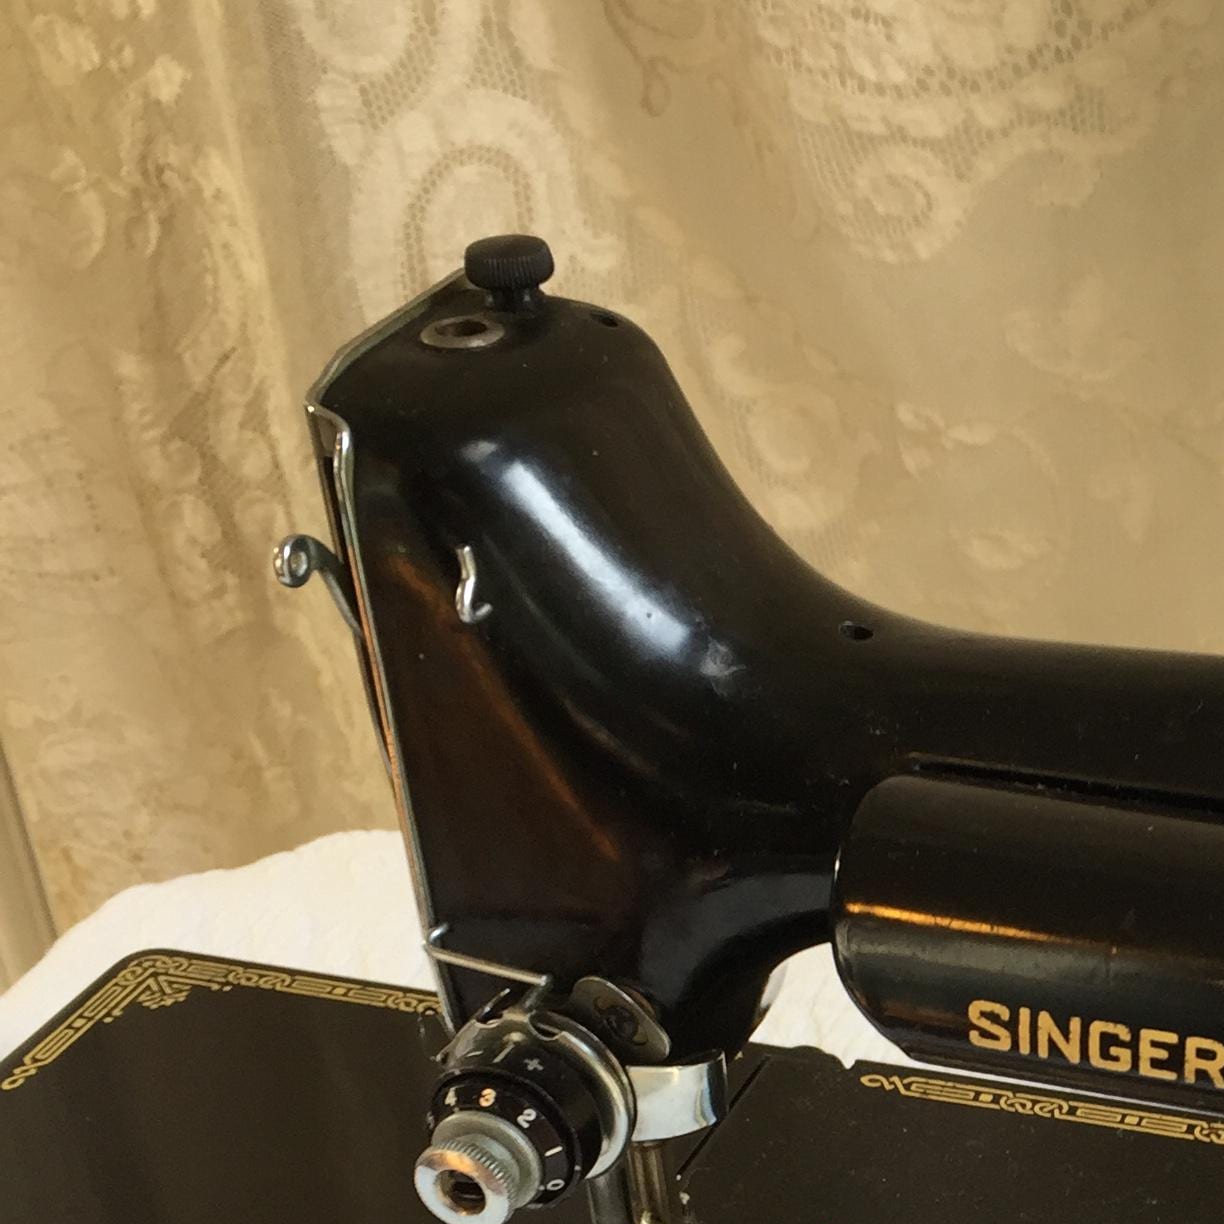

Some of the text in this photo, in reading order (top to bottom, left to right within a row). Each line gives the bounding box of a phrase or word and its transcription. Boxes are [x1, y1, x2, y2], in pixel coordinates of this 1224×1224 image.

[444, 1086, 458, 1106] 4
[478, 1088, 497, 1108] 3
[516, 1108, 537, 1129] 2
[544, 1145, 564, 1157] 1
[546, 1178, 565, 1191] 0
